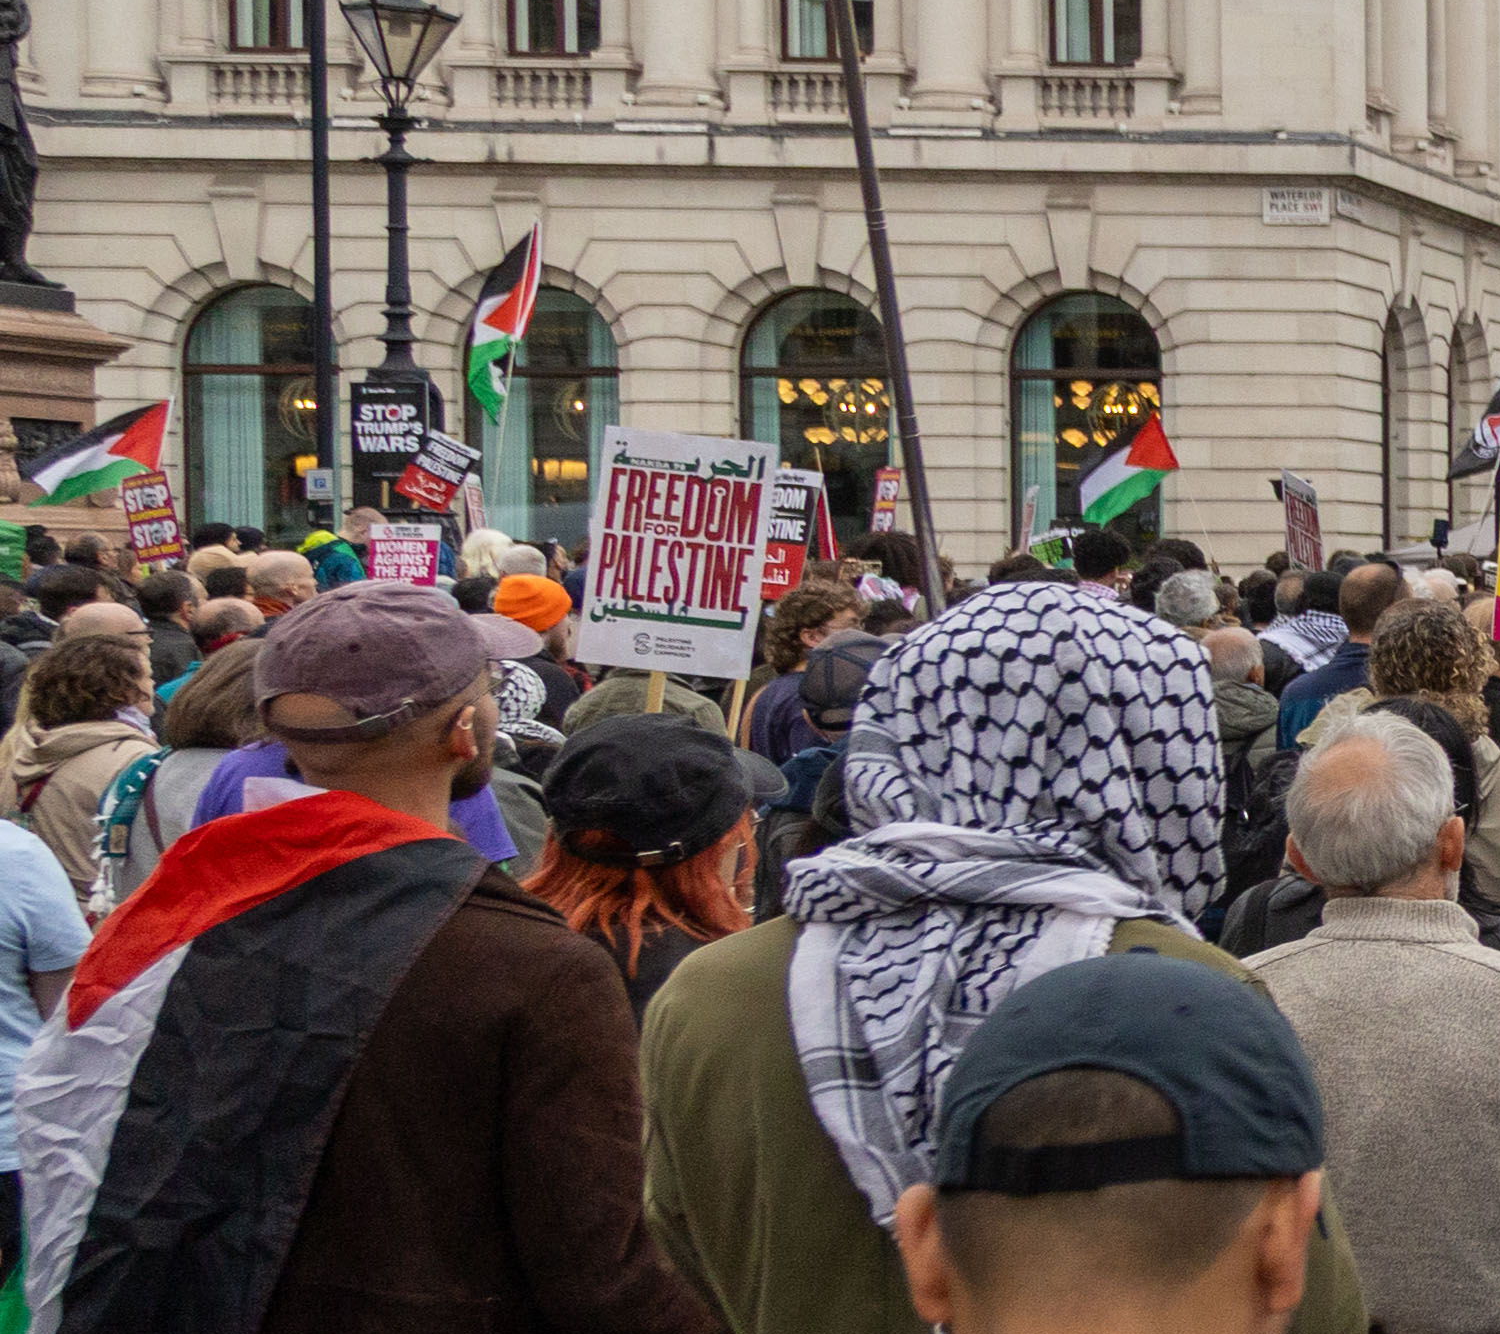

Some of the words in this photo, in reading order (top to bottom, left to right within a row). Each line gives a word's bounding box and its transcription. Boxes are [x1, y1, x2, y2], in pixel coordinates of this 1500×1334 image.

[1269, 191, 1322, 200] WATERLOO
[1269, 203, 1299, 212] PLACE
[360, 404, 417, 421] STOP
[354, 421, 423, 435] TRUMP'S
[359, 436, 420, 453] WARS
[605, 467, 763, 545] FREEDOM
[644, 522, 679, 536] FOR
[375, 541, 427, 555] WOMEN
[373, 554, 434, 566] AGAINST
[374, 566, 398, 578] THE
[400, 566, 428, 578] FAR
[596, 533, 754, 612] PALESTINE
